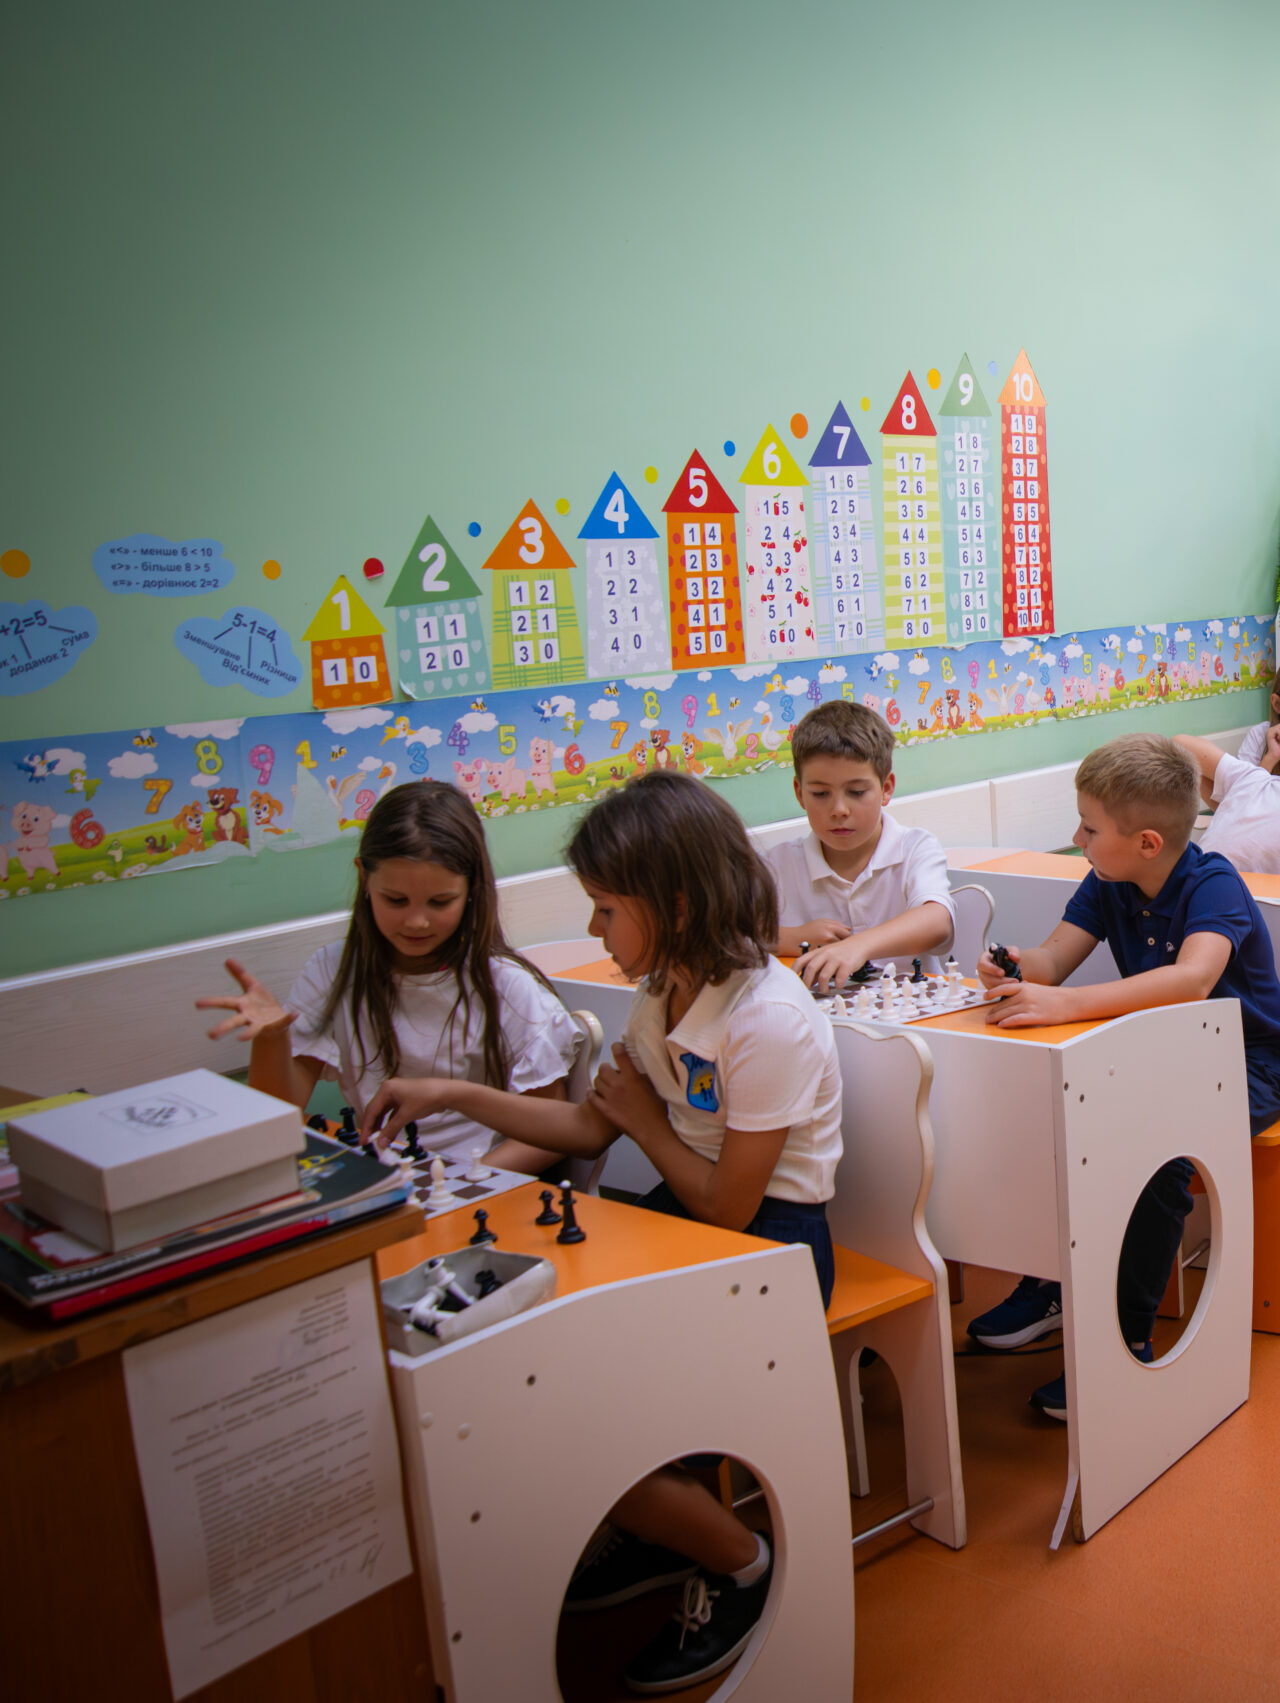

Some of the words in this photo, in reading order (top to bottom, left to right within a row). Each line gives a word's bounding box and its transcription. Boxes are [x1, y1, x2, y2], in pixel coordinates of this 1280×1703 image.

[958, 373, 974, 405] 9
[1012, 373, 1034, 401] 10
[900, 394, 917, 430] 8
[832, 426, 851, 460] 7
[762, 442, 781, 479] 6
[915, 456, 921, 470] 7
[688, 468, 708, 507] 5
[846, 474, 854, 489] 6
[900, 479, 907, 494] 2
[916, 480, 923, 494] 6
[604, 488, 629, 534] 4
[782, 500, 789, 515] 5
[831, 499, 838, 514] 2
[848, 499, 855, 514] 5
[901, 504, 908, 518] 3
[917, 504, 924, 518] 5
[518, 517, 545, 564] 3
[708, 526, 717, 541] 4
[764, 525, 772, 541] 2
[782, 526, 791, 540] 4
[832, 525, 840, 540] 3
[849, 524, 857, 538] 4
[902, 528, 909, 541] 4
[918, 527, 925, 541] 4
[140, 548, 178, 556] менше
[181, 546, 188, 557] 6
[200, 548, 212, 557] 10
[627, 549, 636, 566] 3
[689, 554, 698, 570] 2
[710, 553, 718, 569] 3
[765, 552, 773, 567] 3
[784, 551, 791, 567] 3
[834, 550, 842, 564] 4
[851, 548, 858, 563] 3
[904, 552, 911, 566] 5
[919, 551, 926, 565] 3
[140, 562, 182, 572] більше
[184, 562, 192, 572] 8
[204, 562, 211, 572] 5
[418, 543, 450, 592] 2
[142, 578, 198, 589] дорівнює
[607, 579, 616, 596] 2
[629, 578, 638, 594] 2
[691, 582, 699, 598] 3
[711, 580, 719, 595] 2
[766, 578, 775, 593] 4
[785, 577, 793, 592] 2
[836, 575, 843, 590] 5
[852, 573, 860, 588] 2
[904, 575, 912, 589] 6
[920, 573, 927, 587] 2
[539, 584, 549, 601] 2
[332, 589, 350, 621] 1
[768, 604, 776, 619] 5
[837, 599, 845, 613] 6
[905, 598, 912, 612] 7
[517, 615, 527, 632] 2
[609, 609, 618, 625] 3
[692, 609, 701, 624] 4
[232, 612, 277, 643] 5-1=4
[769, 629, 777, 644] 6
[788, 628, 796, 643] 0
[838, 624, 846, 638] 7
[856, 621, 863, 636] 0
[906, 622, 913, 636] 8
[922, 621, 929, 635] 0
[62, 630, 90, 647] сума
[611, 637, 620, 653] 4
[633, 633, 642, 650] 0
[694, 636, 703, 652] 5
[714, 633, 722, 648] 0
[1154, 634, 1164, 654] 8
[60, 647, 69, 658] 2
[425, 652, 437, 670] 2
[453, 649, 463, 667] 0
[519, 645, 529, 663] 3
[544, 642, 554, 660] 0
[359, 661, 370, 680] 0
[940, 656, 954, 680] 8
[968, 660, 980, 688] 9
[987, 659, 998, 679] 1
[1039, 662, 1050, 686] 3
[1082, 654, 1092, 674] 5
[1137, 654, 1147, 674] 7
[1214, 656, 1224, 677] 6
[1114, 668, 1125, 690] 6
[918, 681, 931, 704] 7
[644, 691, 660, 719] 8
[682, 695, 698, 728] 9
[706, 692, 720, 716] 1
[780, 695, 795, 722] 3
[886, 699, 900, 726] 6
[1014, 694, 1025, 715] 2
[447, 723, 470, 756] 4
[499, 725, 518, 755] 5
[610, 722, 628, 748] 7
[296, 740, 318, 768] 1
[744, 734, 758, 759] 2
[194, 740, 222, 775] 8
[250, 744, 274, 785] 9
[407, 742, 429, 775] 3
[564, 744, 585, 776] 6
[144, 778, 172, 814] 7
[354, 789, 376, 820] 2
[70, 808, 105, 849] 6
